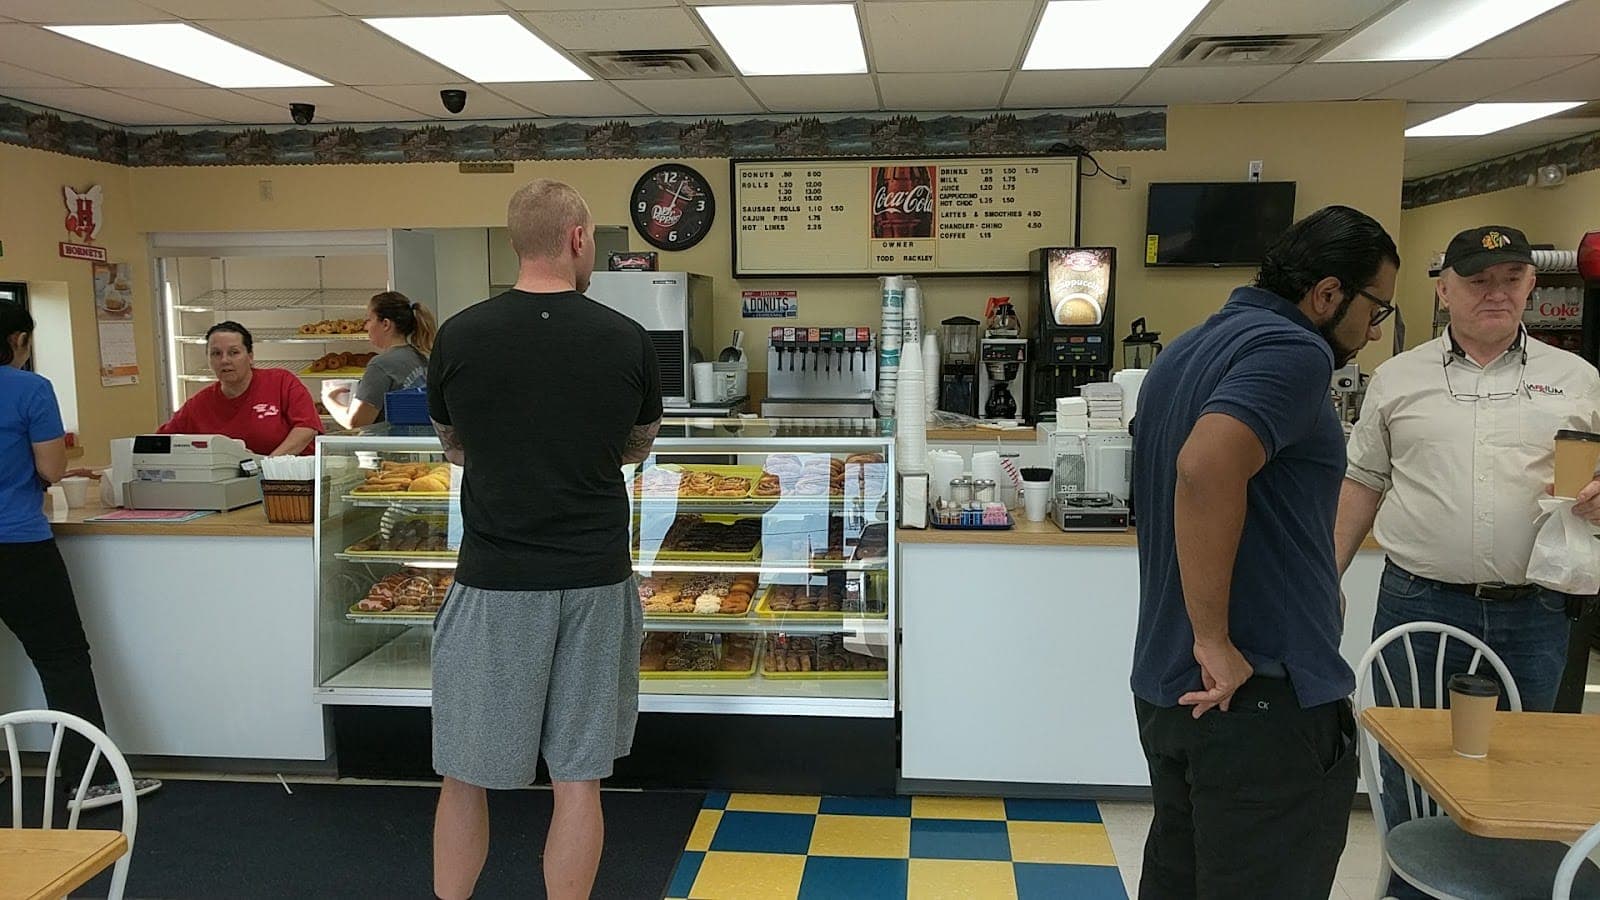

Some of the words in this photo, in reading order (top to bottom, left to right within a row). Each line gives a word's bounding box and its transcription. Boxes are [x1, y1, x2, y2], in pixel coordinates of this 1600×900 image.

[742, 171, 775, 179] DONUTS
[940, 168, 969, 176] DRINKS
[663, 171, 678, 183] 12
[939, 176, 958, 184] MILK
[1002, 175, 1017, 183] 1.75
[741, 181, 769, 189] ROLLS
[939, 184, 960, 192] JUICE
[1002, 183, 1016, 191] 1.75
[939, 192, 978, 200] CAPPUCCINO
[637, 201, 647, 213] 9
[695, 200, 706, 212] 3
[956, 199, 973, 207] CHOC
[779, 205, 801, 213] ROLLS
[940, 211, 967, 219] LATTES
[984, 210, 1023, 218] SMOOTHIES
[980, 222, 1003, 230] CHINO
[668, 230, 678, 242] 6
[939, 232, 966, 240] COFFEE
[882, 239, 914, 248] OWNER
[750, 297, 789, 312] DONUTS
[1539, 302, 1580, 317] Coke
